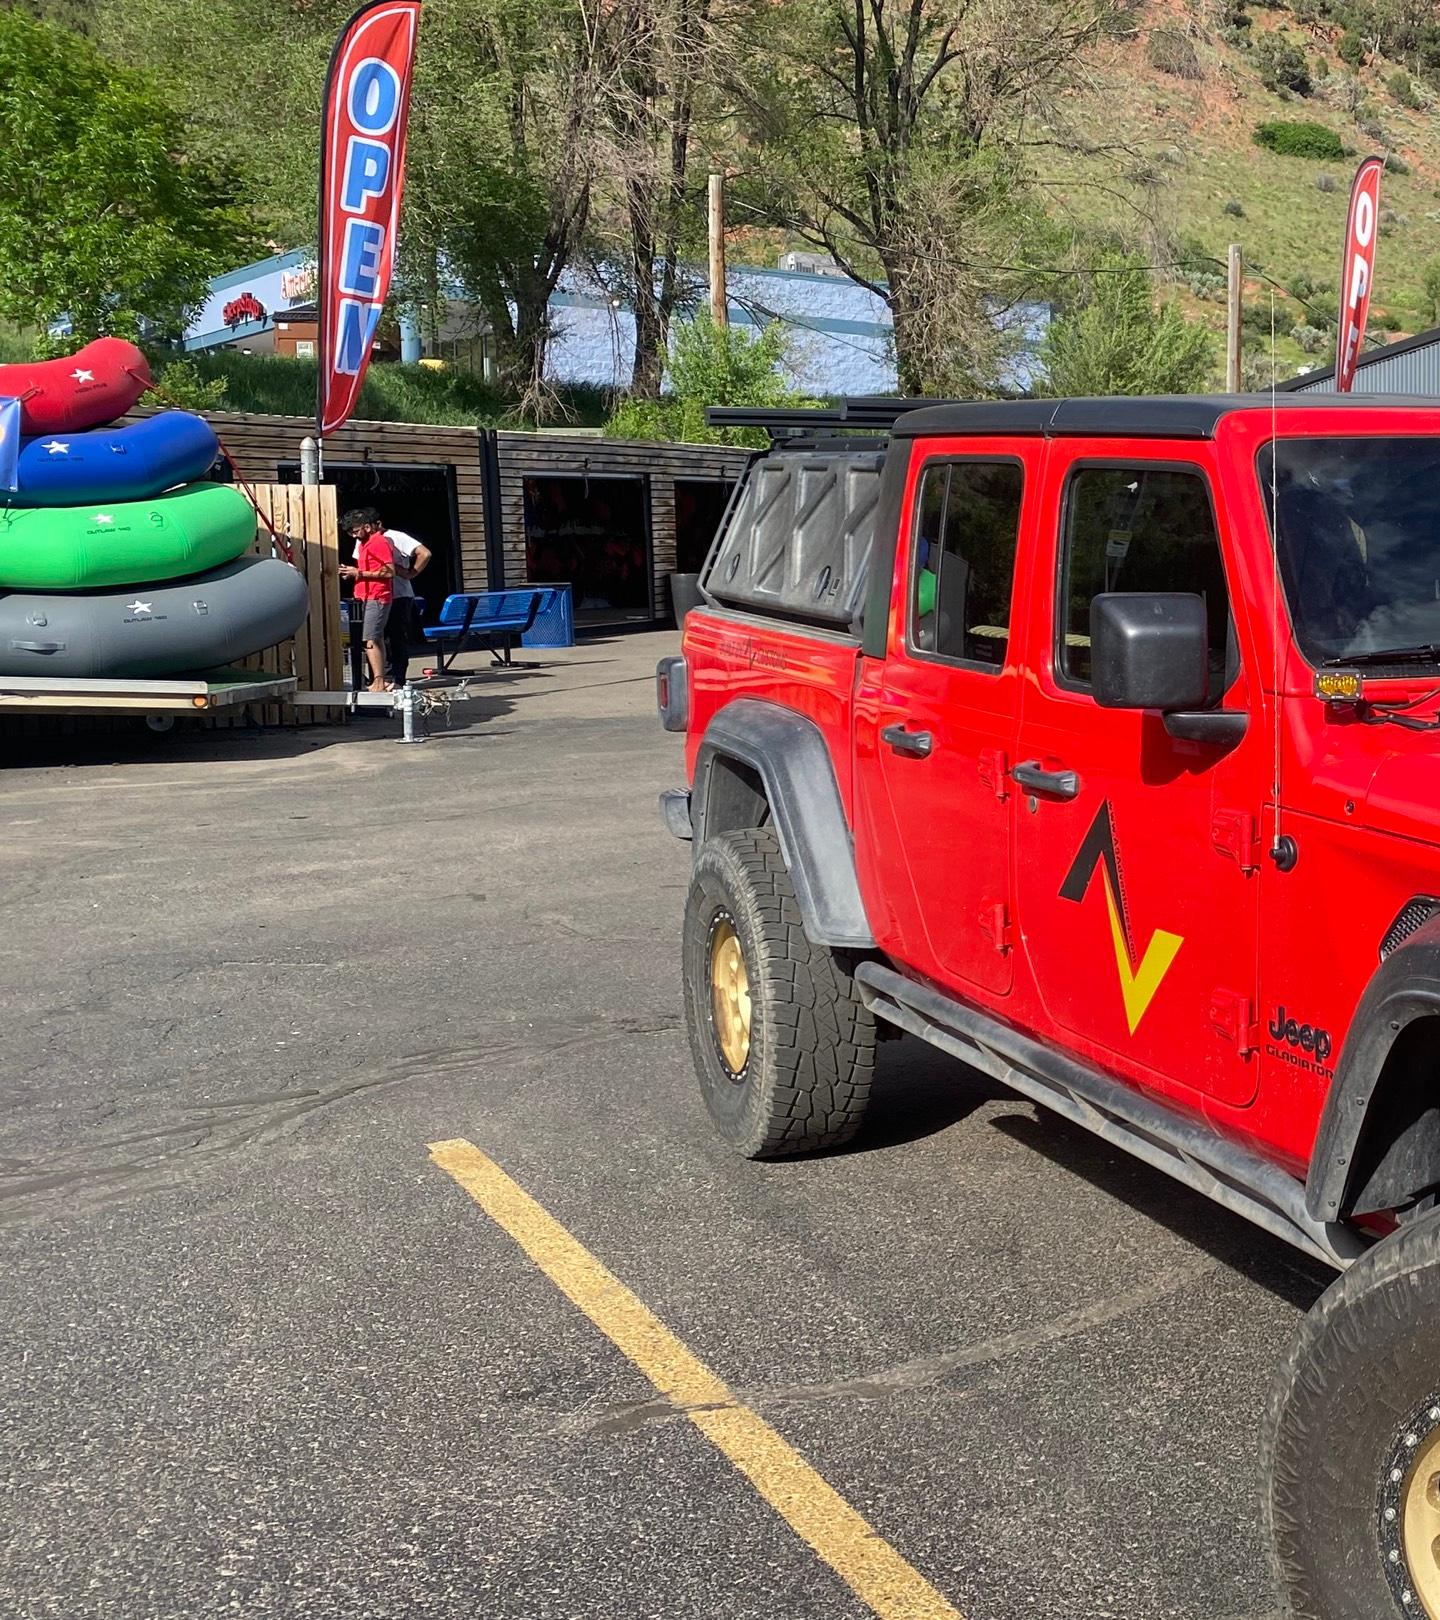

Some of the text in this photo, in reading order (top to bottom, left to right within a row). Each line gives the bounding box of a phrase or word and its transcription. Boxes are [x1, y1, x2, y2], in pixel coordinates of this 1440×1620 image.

[335, 57, 400, 375] OPEN
[1343, 191, 1374, 378] OPE
[1265, 1043, 1335, 1080] GLADIATOR
[1268, 1005, 1332, 1064] Jeep
